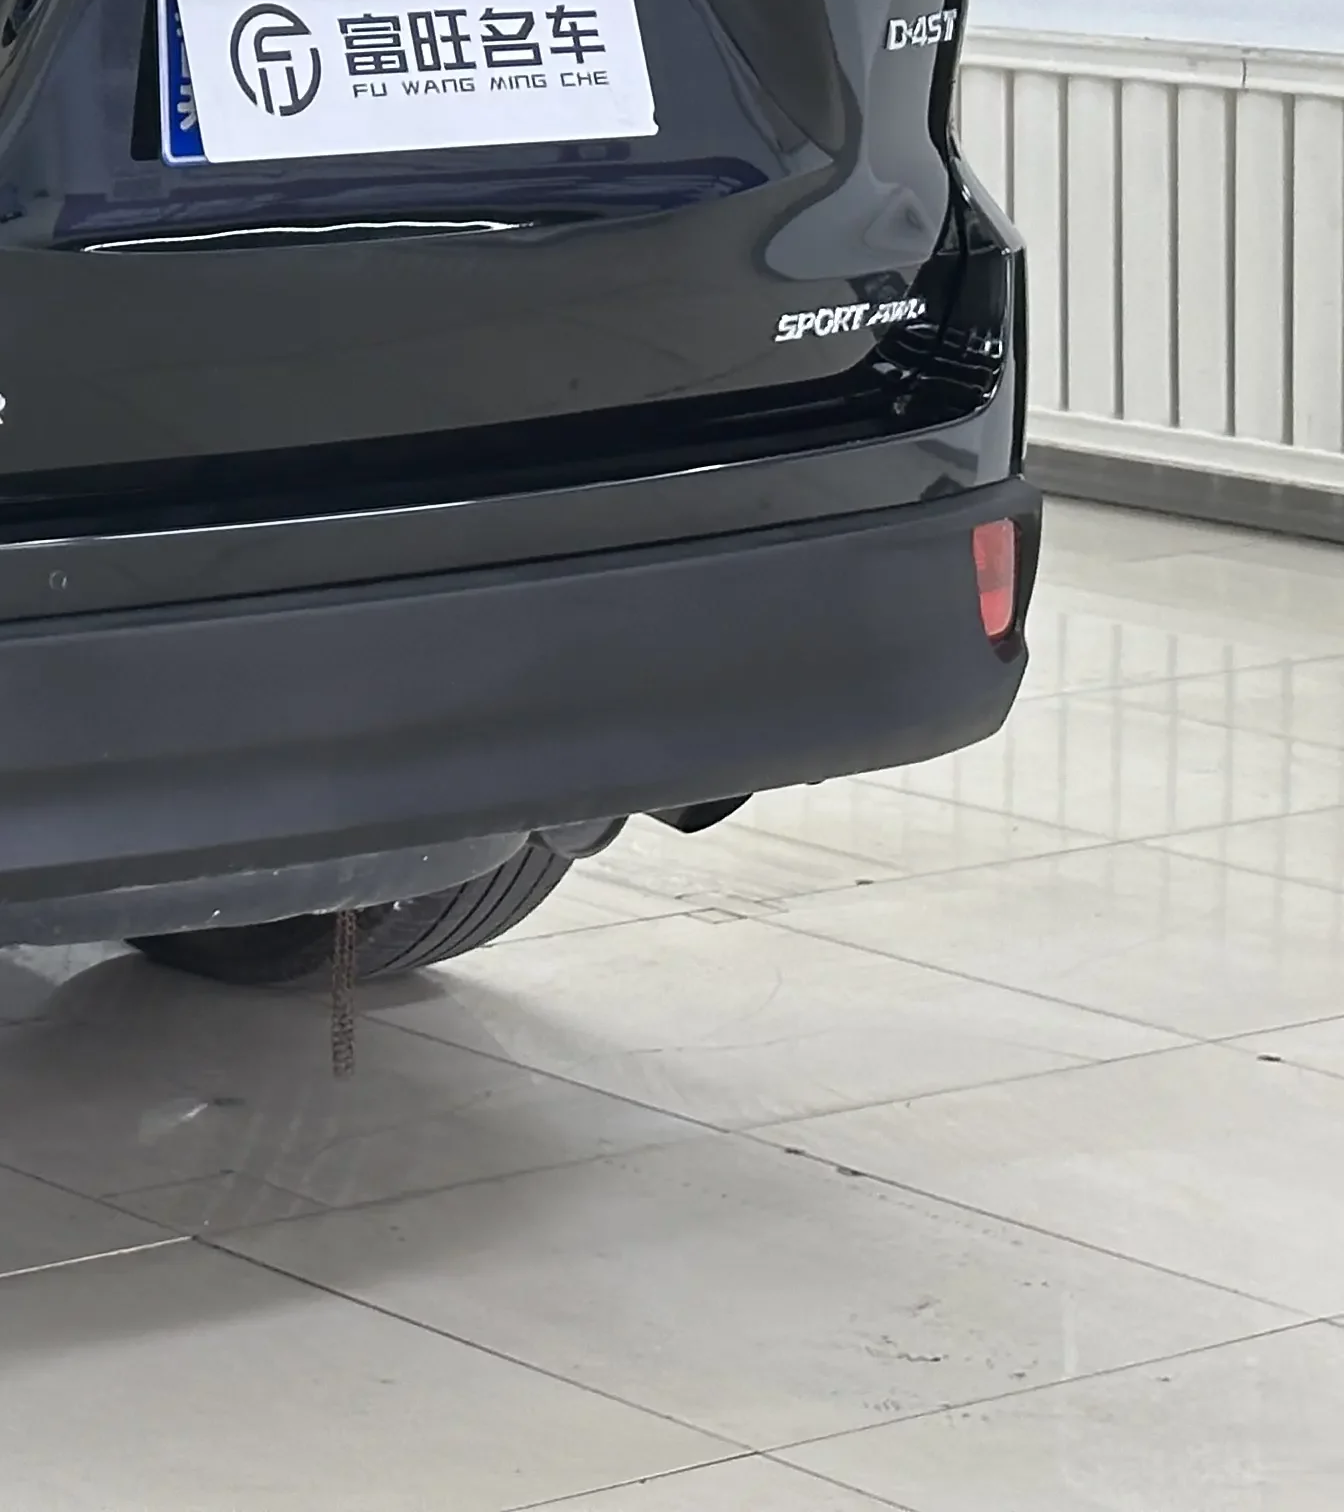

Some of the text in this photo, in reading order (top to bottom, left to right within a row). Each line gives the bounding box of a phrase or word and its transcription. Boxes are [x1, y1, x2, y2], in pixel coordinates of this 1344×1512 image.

[337, 4, 606, 76] 富旺名车
[353, 71, 610, 98] FU WANG MING CHE
[774, 303, 870, 342] SPORT
